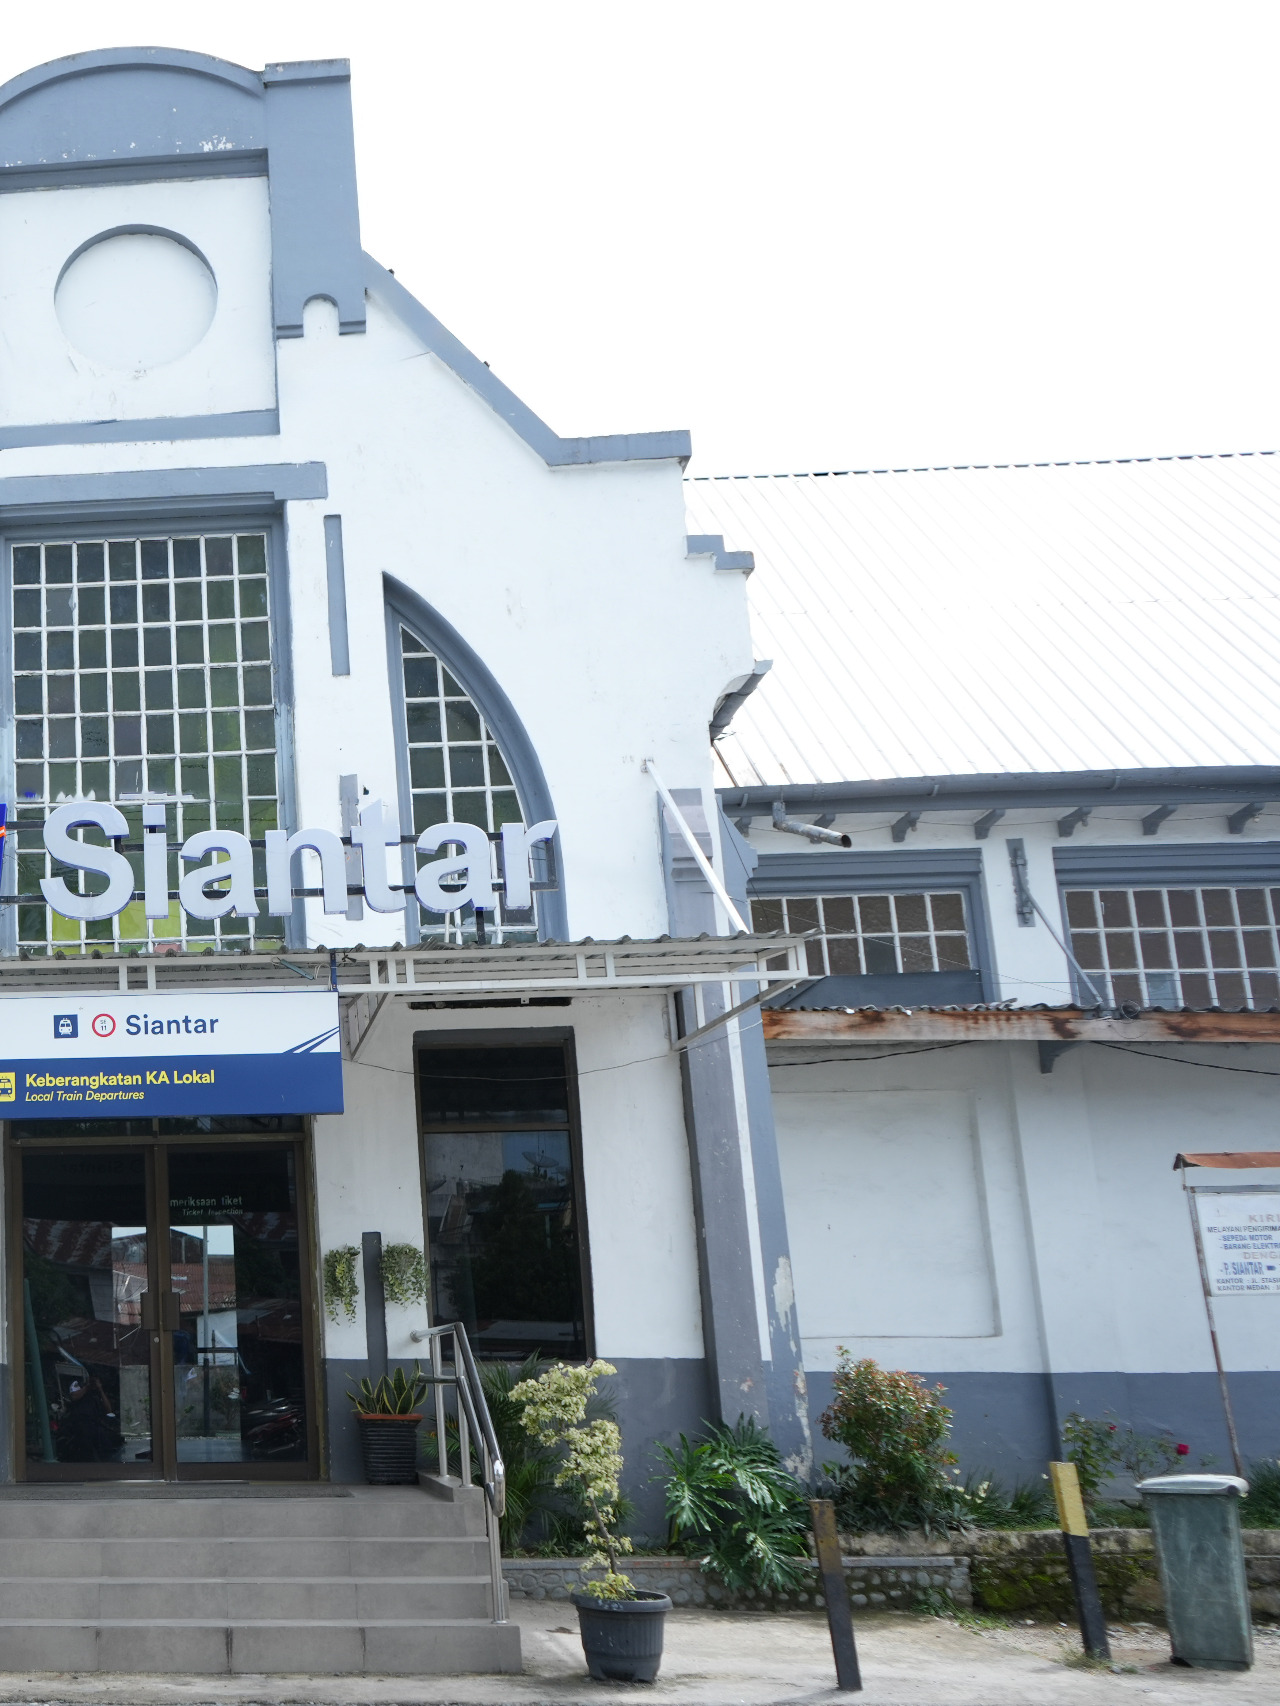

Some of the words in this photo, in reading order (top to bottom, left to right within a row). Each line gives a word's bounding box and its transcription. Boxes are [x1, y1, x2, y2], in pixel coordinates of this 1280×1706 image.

[39, 800, 557, 921] Siantar
[125, 1013, 218, 1036] Siantar
[26, 1072, 142, 1090] Keberangkatan
[146, 1070, 170, 1085] KA
[174, 1069, 215, 1084] Lokal
[25, 1090, 54, 1102] Local
[56, 1090, 83, 1102] Train
[85, 1089, 145, 1102] Departures
[169, 1196, 217, 1207] meriksaan
[1207, 1225, 1242, 1233] MELAYANI
[1243, 1251, 1280, 1260] DENG
[1232, 1261, 1264, 1276] SIANTAR
